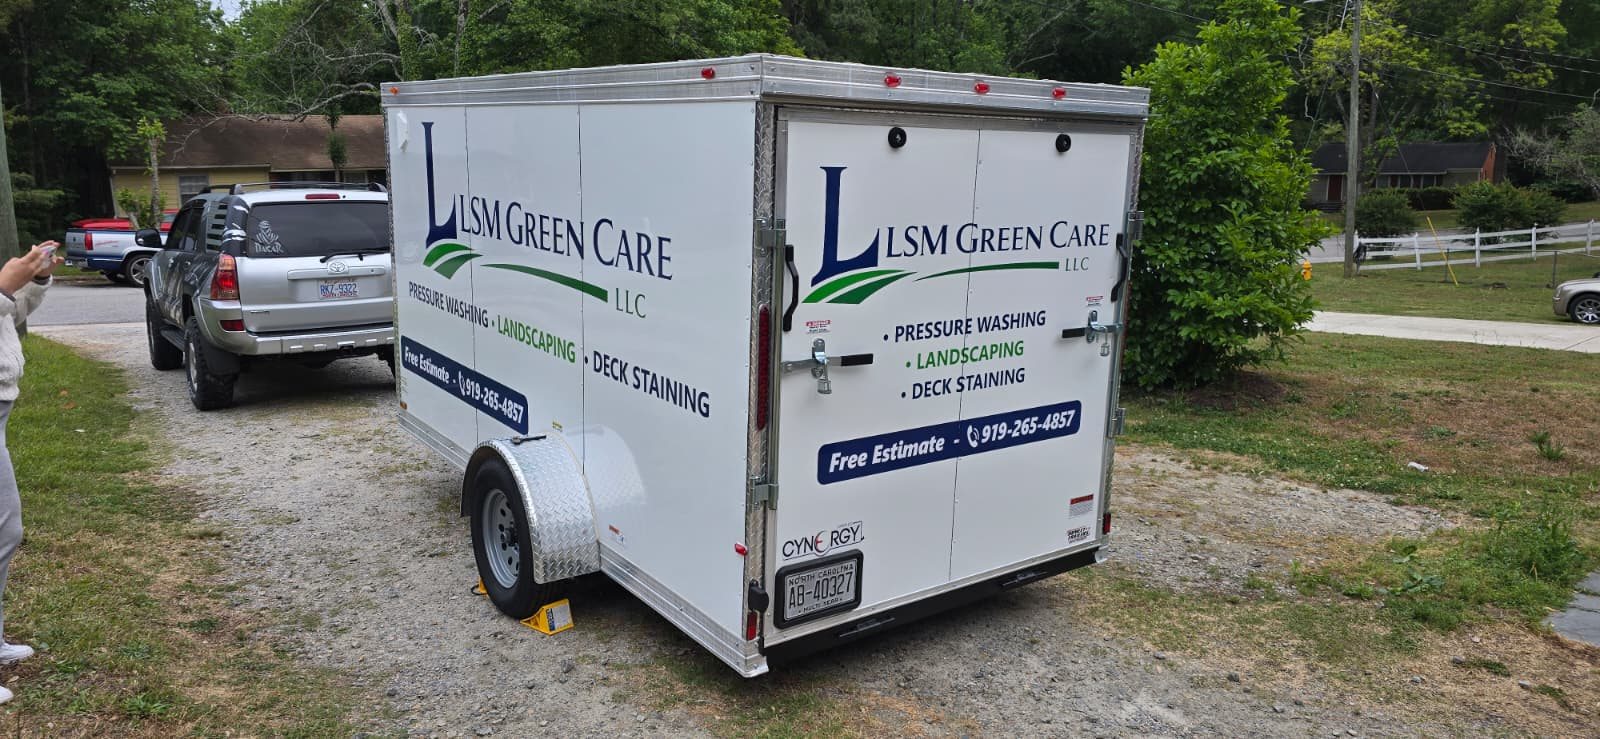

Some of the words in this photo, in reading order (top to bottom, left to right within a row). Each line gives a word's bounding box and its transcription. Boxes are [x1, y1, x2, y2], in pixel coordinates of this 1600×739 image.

[255, 242, 284, 253] DAKAR
[460, 194, 502, 240] LSM
[506, 201, 585, 260] GREEN
[593, 218, 673, 281] CARE
[886, 224, 948, 258] LSM
[956, 222, 1043, 254] GREEN
[1050, 220, 1110, 248] CARE
[1065, 257, 1090, 271] LLC
[615, 287, 647, 318] LLC
[894, 317, 972, 343] PRESSURE
[977, 310, 1046, 333] WASHING
[409, 281, 444, 311] PRESSURE
[446, 295, 489, 328] WASHING
[497, 315, 576, 363] LANDSCAPING
[593, 350, 628, 386] DECK
[632, 367, 710, 418] STAINING
[916, 340, 1025, 370] LANDSCAPING
[404, 346, 418, 368] Free
[420, 353, 449, 384] Estimate
[465, 379, 524, 424] 919-265-4857
[911, 377, 951, 400] DECK
[956, 367, 1025, 393] STAINING
[828, 452, 867, 473] Free
[872, 435, 945, 464] Estimate
[981, 409, 1075, 440] 919-265-4857
[789, 574, 815, 587] NORTH
[818, 563, 854, 579] CAROLINA
[789, 571, 853, 609] AB-40327
